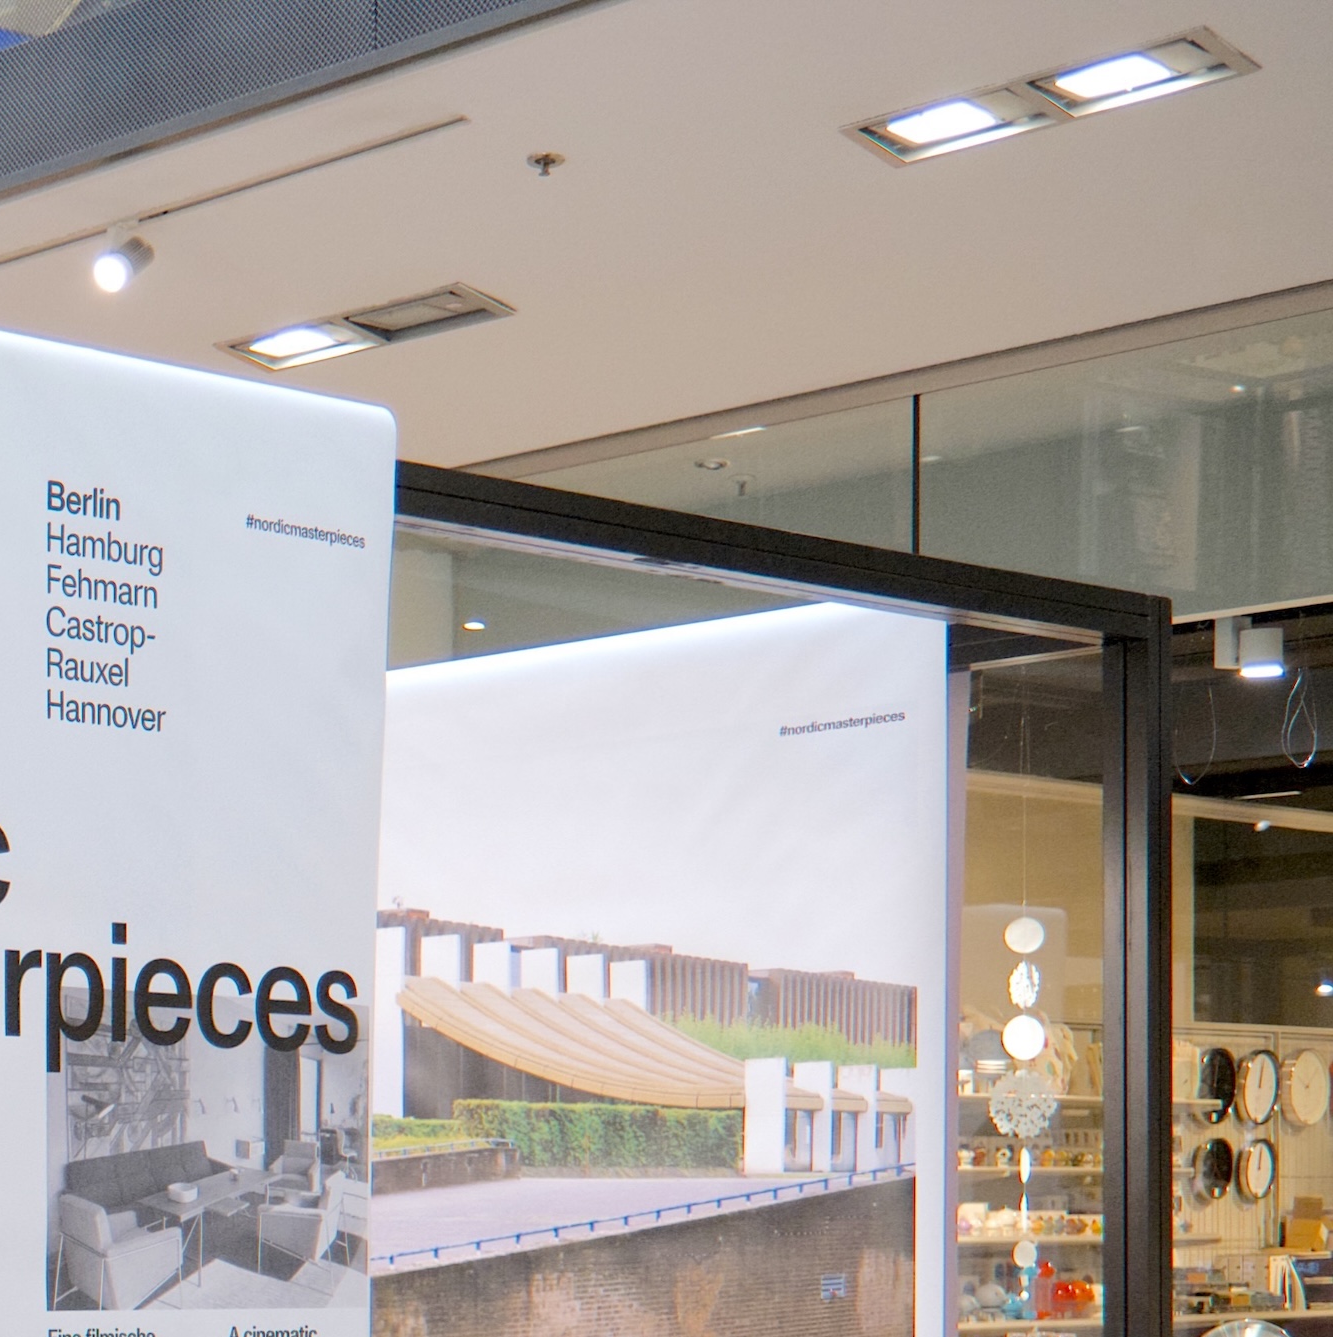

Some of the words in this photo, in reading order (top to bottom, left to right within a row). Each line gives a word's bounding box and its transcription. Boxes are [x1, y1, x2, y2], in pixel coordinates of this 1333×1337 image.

[47, 480, 120, 521] Berlin
[47, 522, 163, 576] Hamburg
[246, 514, 365, 549] #nordicmasterpieces
[47, 564, 157, 608] Fehmarn
[46, 606, 156, 654] Castrop-
[47, 648, 129, 687] Rauxel
[47, 689, 165, 732] Hannover
[779, 712, 905, 736] #nordicmasterpieces
